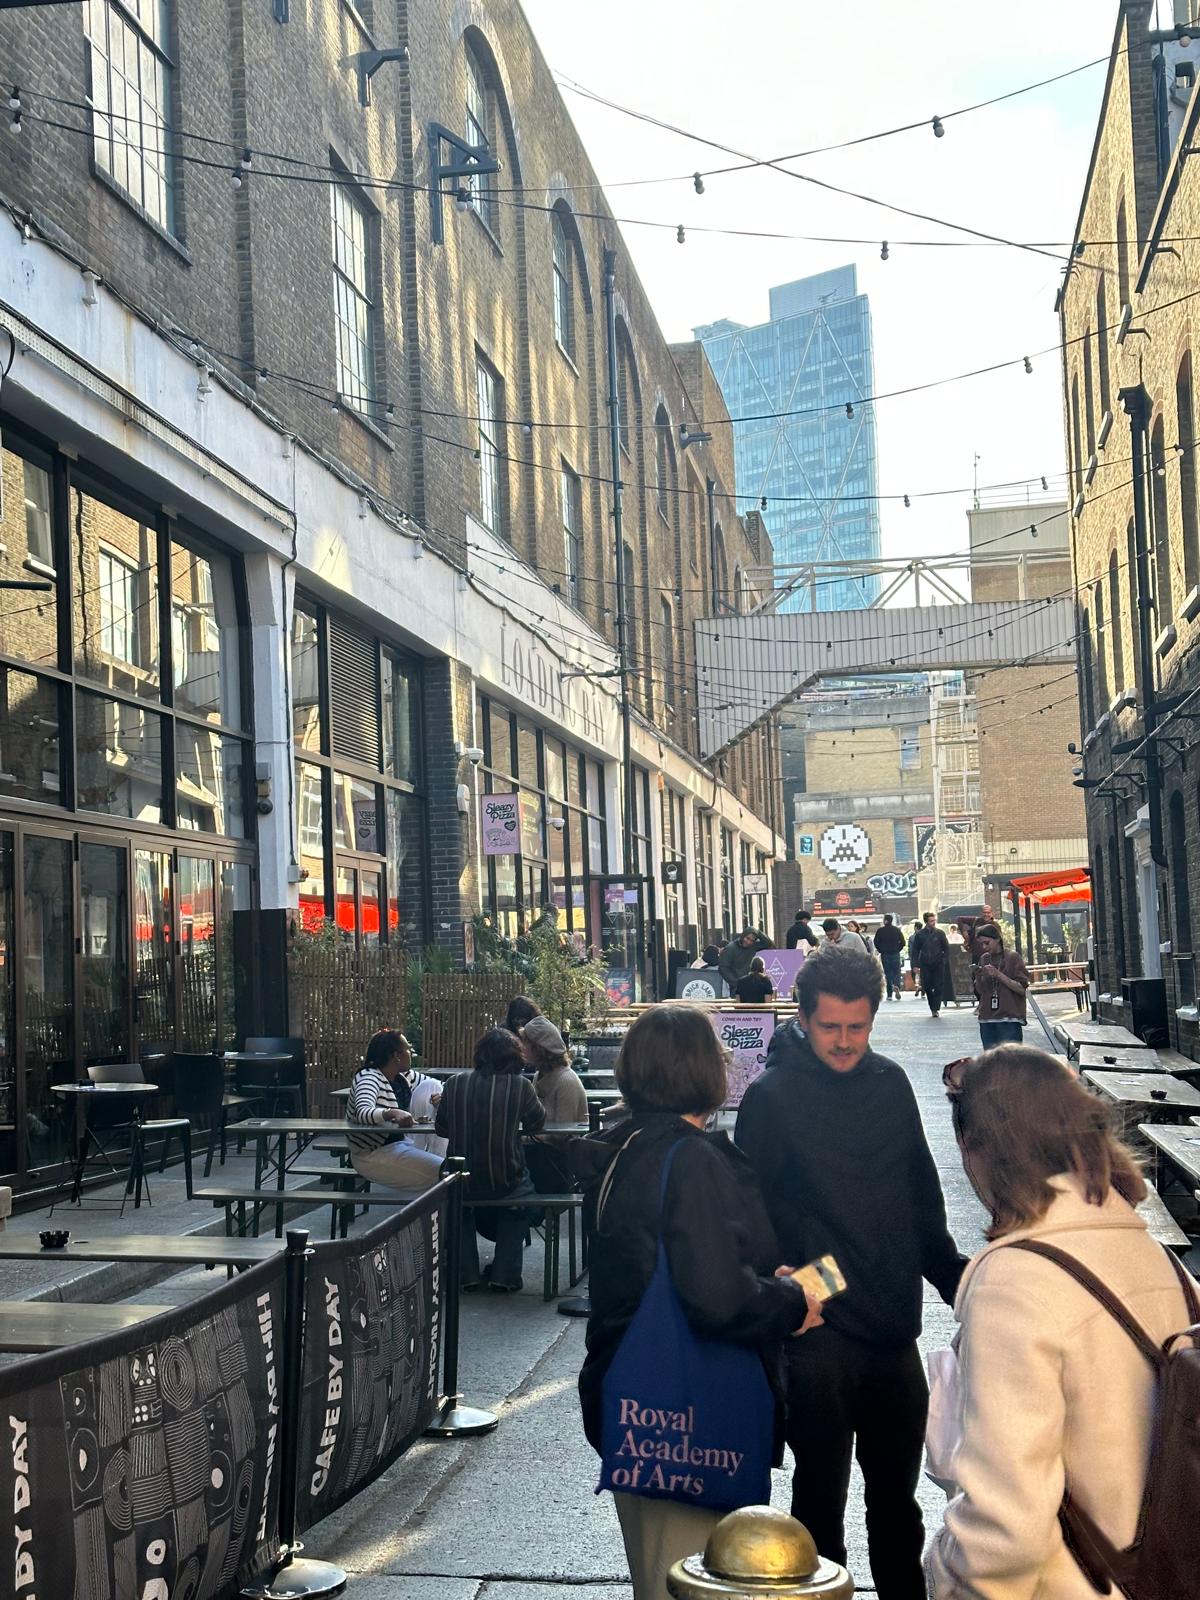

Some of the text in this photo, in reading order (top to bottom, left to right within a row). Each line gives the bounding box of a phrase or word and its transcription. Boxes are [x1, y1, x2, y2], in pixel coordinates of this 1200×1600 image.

[500, 627, 605, 746] LOADING BAY
[485, 803, 515, 815] Sleazy
[490, 811, 516, 824] Pizza
[684, 982, 714, 998] BRICK LANE
[721, 1024, 763, 1041] Sleazy
[727, 1037, 764, 1050] Pizza
[309, 1276, 344, 1497] CAFE BY DAY
[619, 1398, 694, 1435] Royal
[8, 1414, 32, 1514] DAY
[615, 1428, 744, 1477] Academy
[611, 1459, 705, 1496] of Arts
